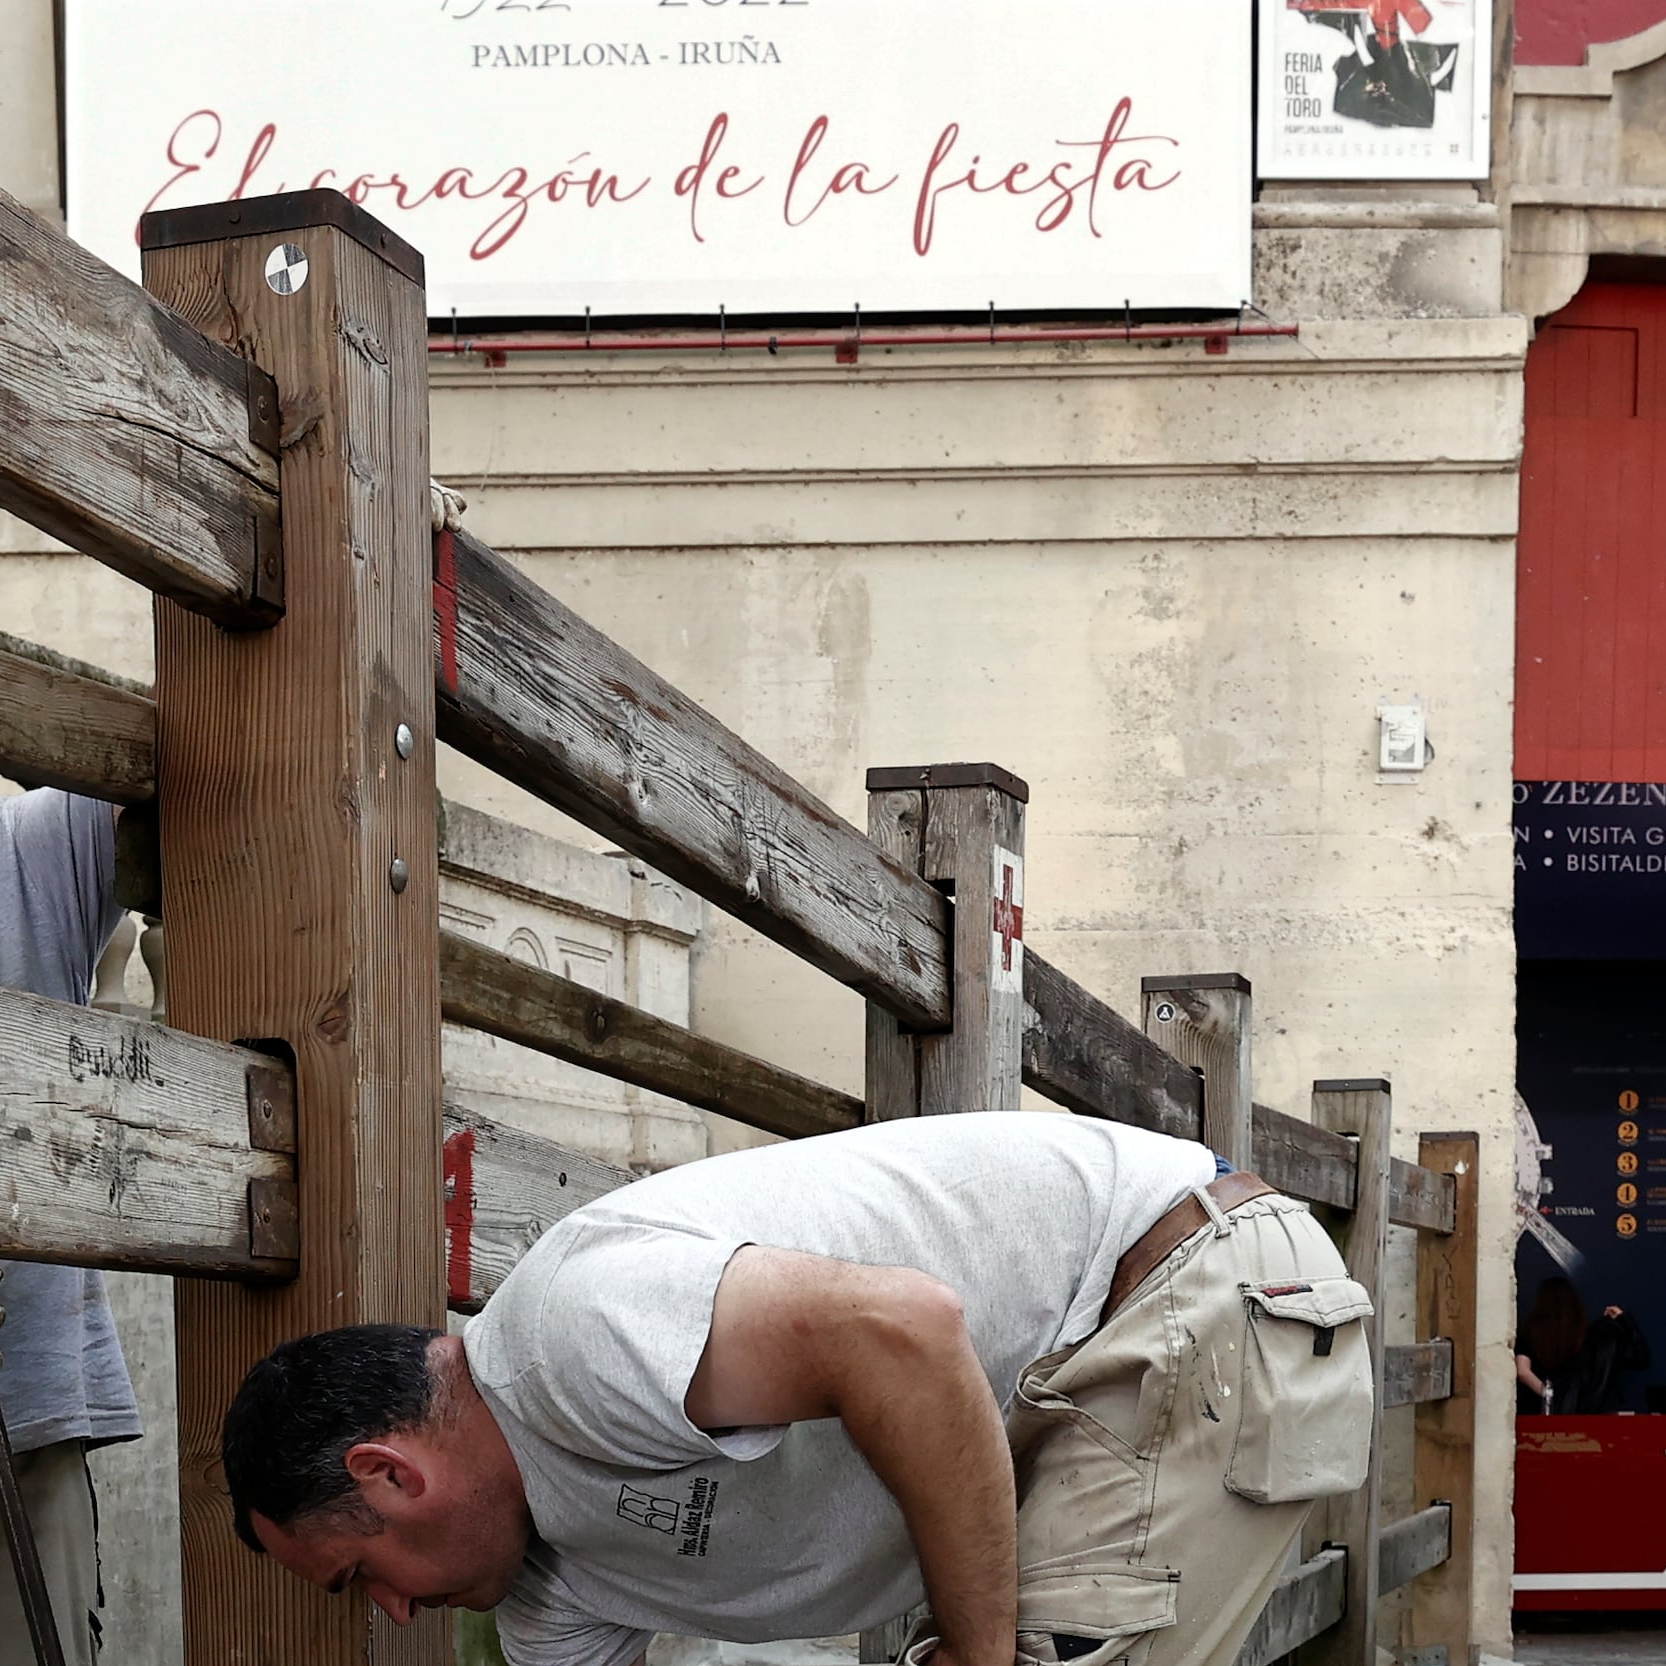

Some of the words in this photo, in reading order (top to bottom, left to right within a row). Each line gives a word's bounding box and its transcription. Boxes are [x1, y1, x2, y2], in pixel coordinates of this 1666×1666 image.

[471, 44, 650, 68] PAMPLONA
[678, 35, 782, 65] IRUÑA
[1285, 52, 1323, 73] FERIA
[1285, 75, 1309, 96] DEL
[1285, 97, 1322, 118] TORO
[135, 108, 285, 248] El
[674, 112, 764, 242] de
[784, 114, 899, 227] la
[913, 96, 1181, 256] fiesta
[1566, 826, 1637, 845] VISITA
[1623, 1092, 1633, 1109] 1
[1621, 1125, 1634, 1140] 2
[1620, 1154, 1634, 1172] 3
[1554, 1206, 1595, 1216] ENTRADA
[1619, 1215, 1633, 1232] 5
